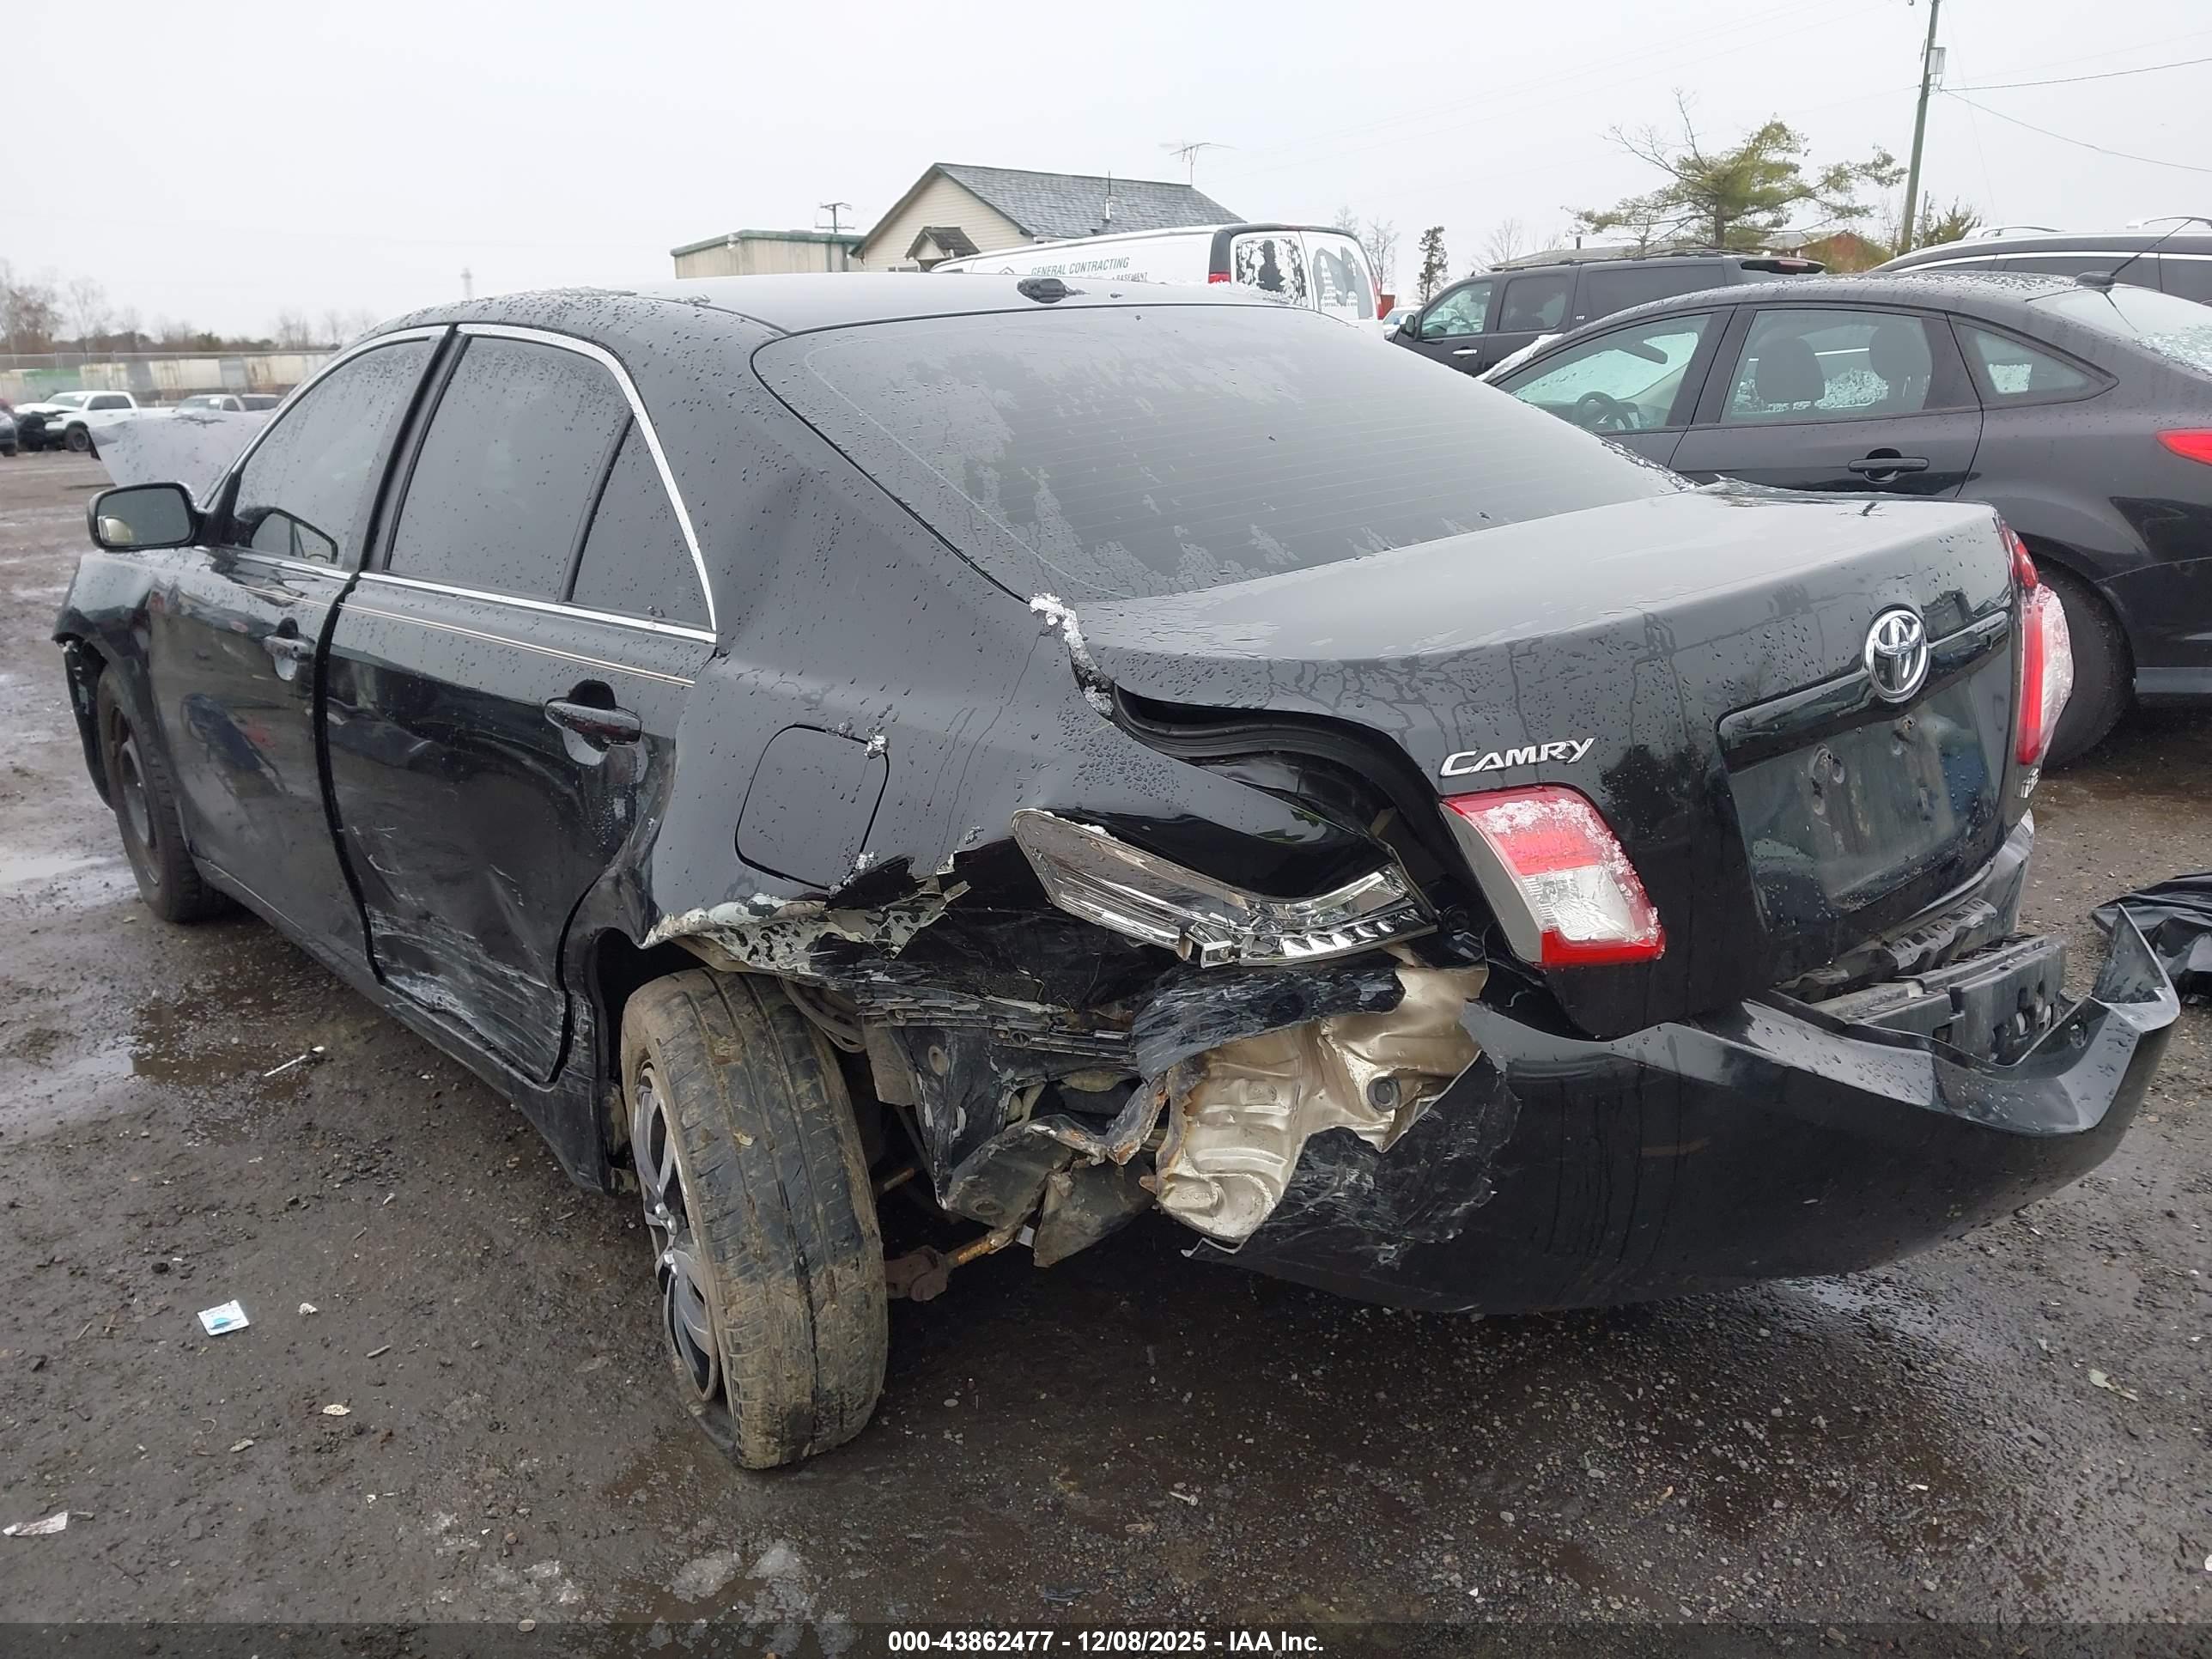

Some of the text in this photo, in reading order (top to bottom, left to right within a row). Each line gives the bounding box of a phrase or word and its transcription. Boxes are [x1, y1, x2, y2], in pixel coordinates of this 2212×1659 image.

[1031, 257, 1130, 276] GENERAL CONTRACTING
[1439, 737, 1595, 776] CAMRY
